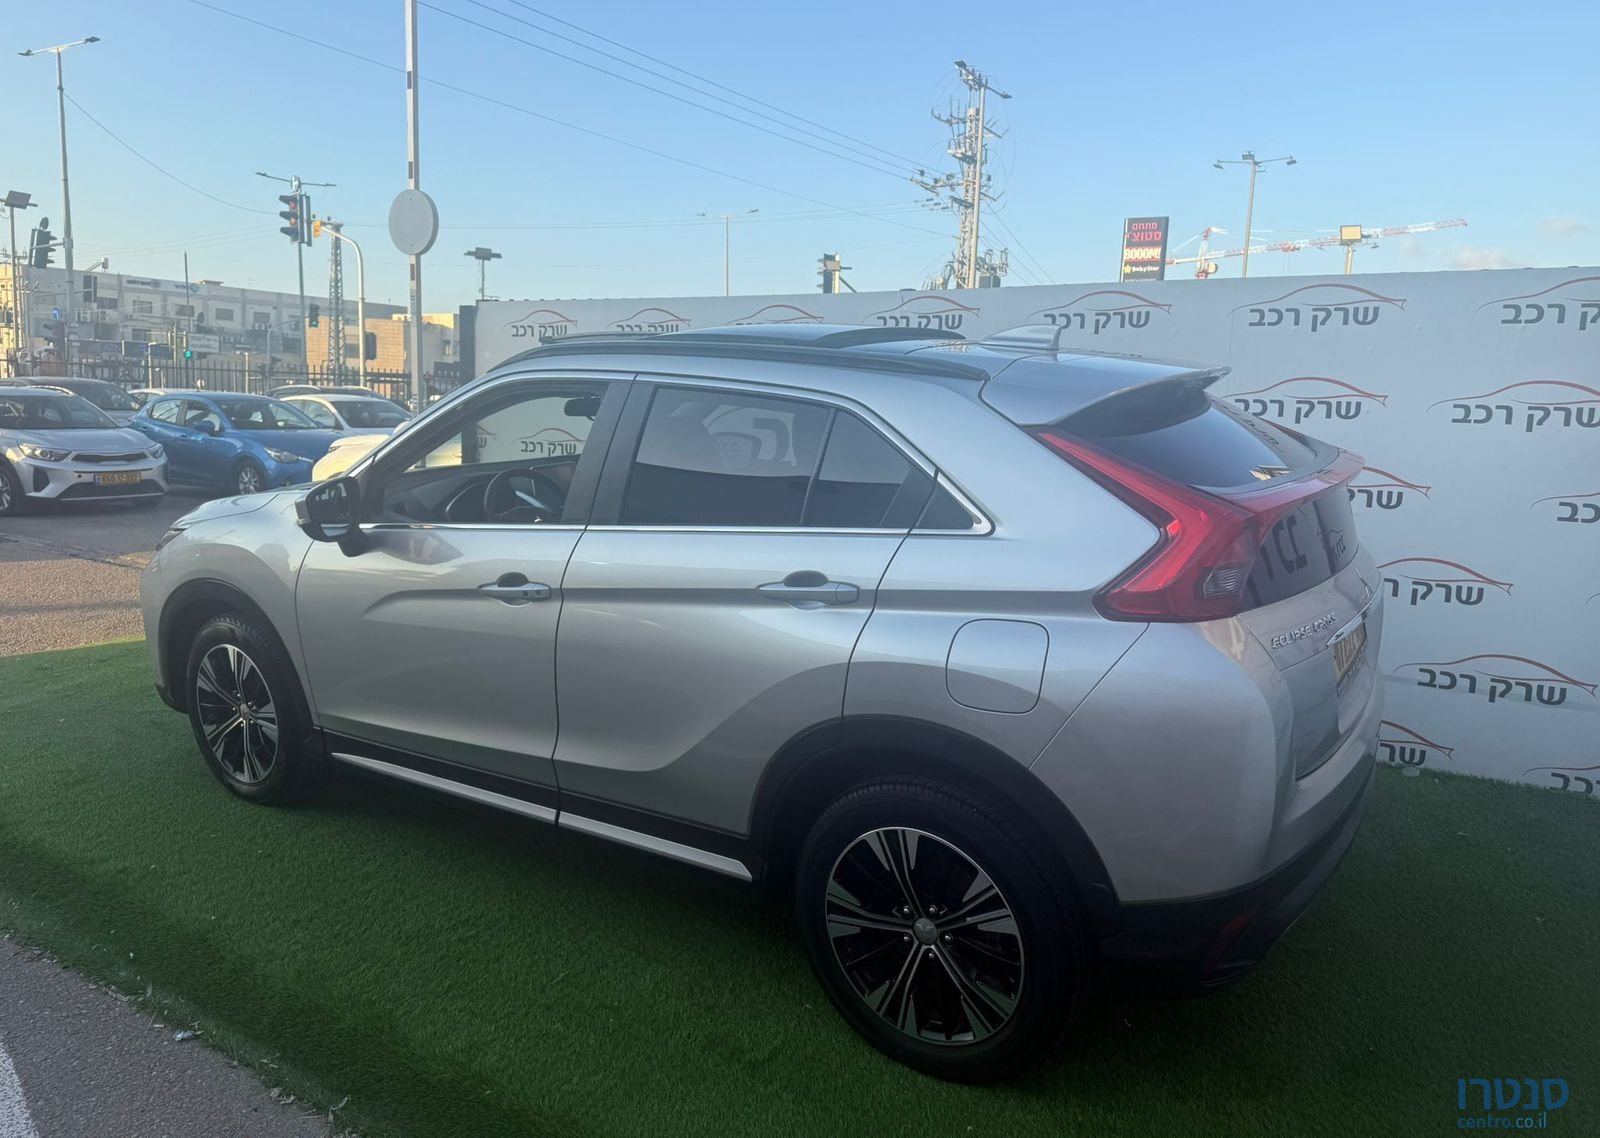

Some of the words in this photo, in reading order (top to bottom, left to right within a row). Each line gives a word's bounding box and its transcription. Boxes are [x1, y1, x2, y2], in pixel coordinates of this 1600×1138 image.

[1125, 247, 1161, 260] BOOOM!
[918, 314, 963, 329] שרק
[1094, 311, 1150, 335] שרק
[1249, 308, 1300, 326] רכב
[1311, 306, 1379, 332] שרק
[1501, 303, 1566, 324] רכב
[512, 325, 534, 337] רכב
[538, 325, 567, 338] שרק
[1295, 400, 1361, 424] שרק
[1451, 404, 1513, 425] רכב
[521, 441, 543, 453] רכב
[547, 442, 577, 457] שרק
[1411, 580, 1484, 606] שרק
[1271, 625, 1313, 650] ECLIPSE
[1416, 668, 1477, 694] רכב
[1488, 677, 1567, 706] שרק
